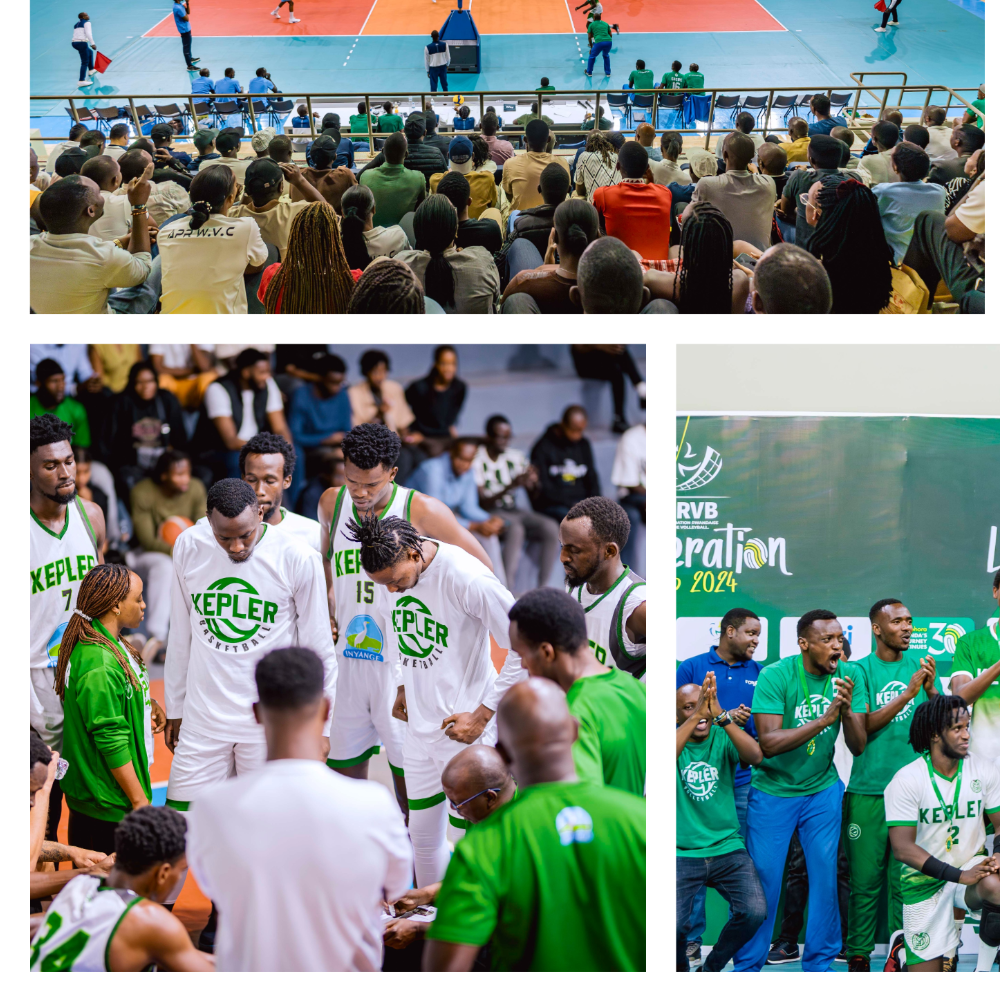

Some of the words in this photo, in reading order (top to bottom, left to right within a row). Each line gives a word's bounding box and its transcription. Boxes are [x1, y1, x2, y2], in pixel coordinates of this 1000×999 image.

[357, 581, 374, 604] 15
[690, 571, 738, 593] 2024
[62, 588, 72, 611] 7
[191, 593, 279, 624] KEPLER
[345, 650, 381, 661] INYANGE
[947, 825, 960, 844] 2
